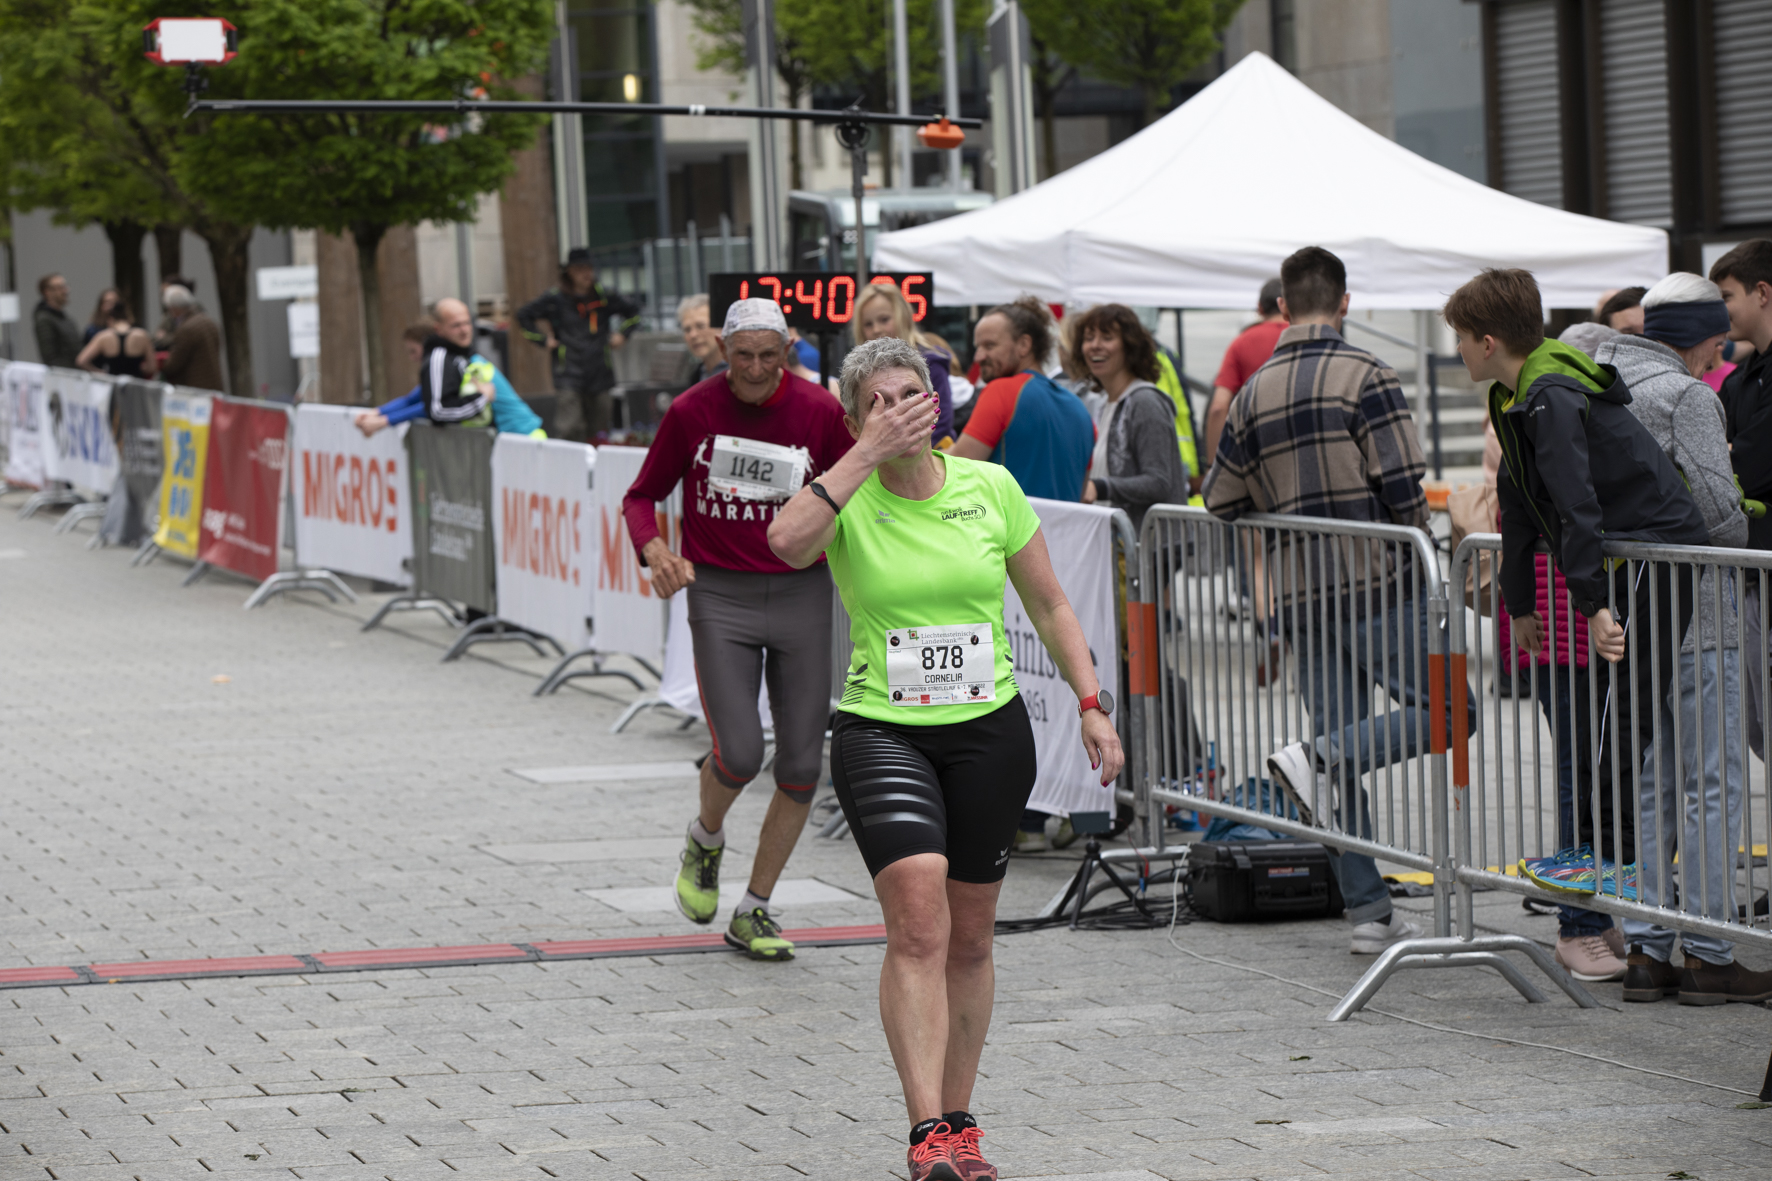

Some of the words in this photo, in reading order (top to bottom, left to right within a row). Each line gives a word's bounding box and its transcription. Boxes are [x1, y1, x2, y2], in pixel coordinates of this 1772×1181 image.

[730, 455, 775, 482] 1142
[303, 450, 398, 532] MIGROS
[875, 517, 896, 525] erima
[941, 509, 978, 521] LAUF-TREFF
[502, 487, 581, 587] MIGROS
[921, 630, 975, 639] Liechtensteinische
[921, 637, 957, 645] Landesbank
[921, 645, 964, 670] 878
[924, 672, 963, 684] CORNELIA
[1024, 688, 1049, 722] 861
